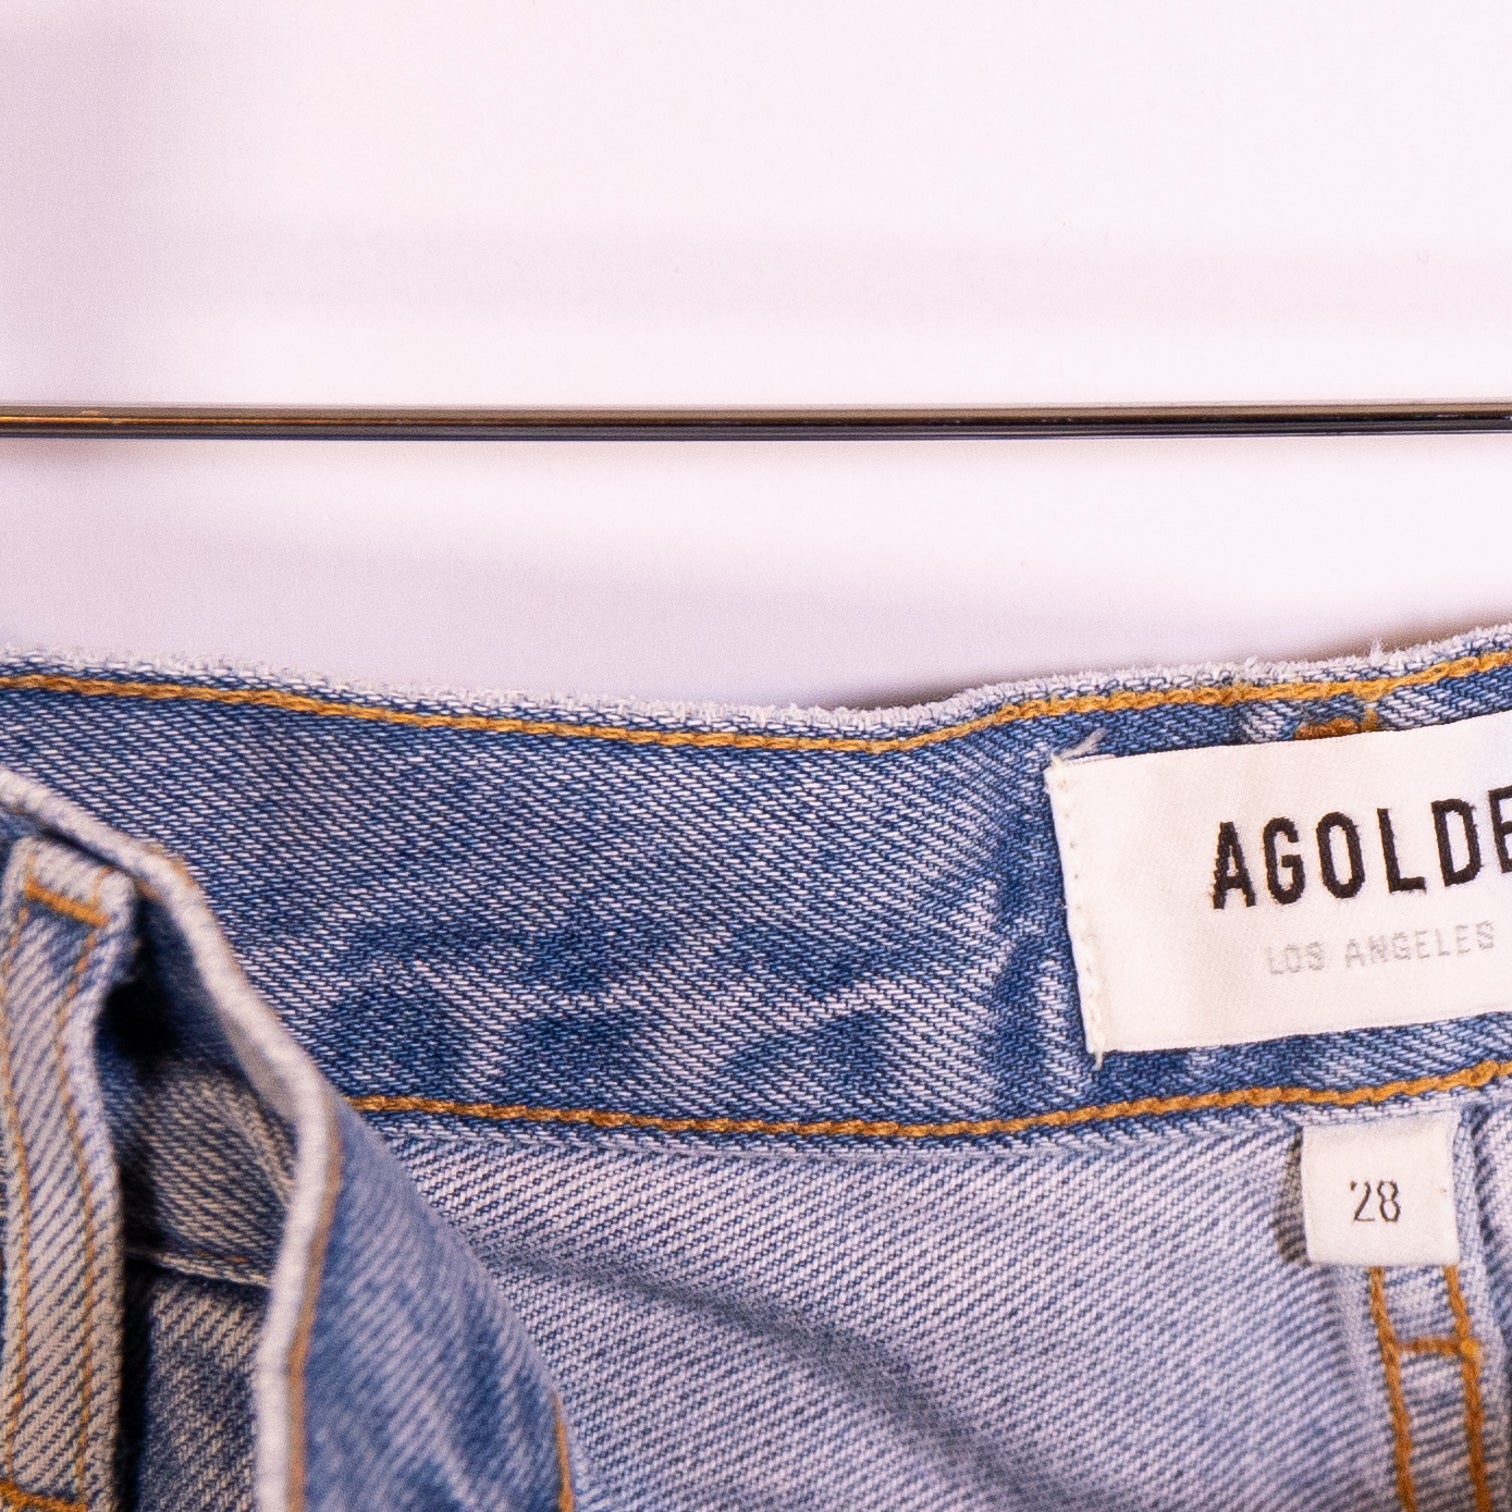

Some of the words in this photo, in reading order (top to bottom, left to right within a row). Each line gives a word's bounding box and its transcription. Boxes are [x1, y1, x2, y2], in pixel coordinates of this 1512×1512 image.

[1266, 941, 1325, 975] LOS
[1345, 920, 1495, 968] ANGELES
[1350, 1179, 1401, 1223] 28
